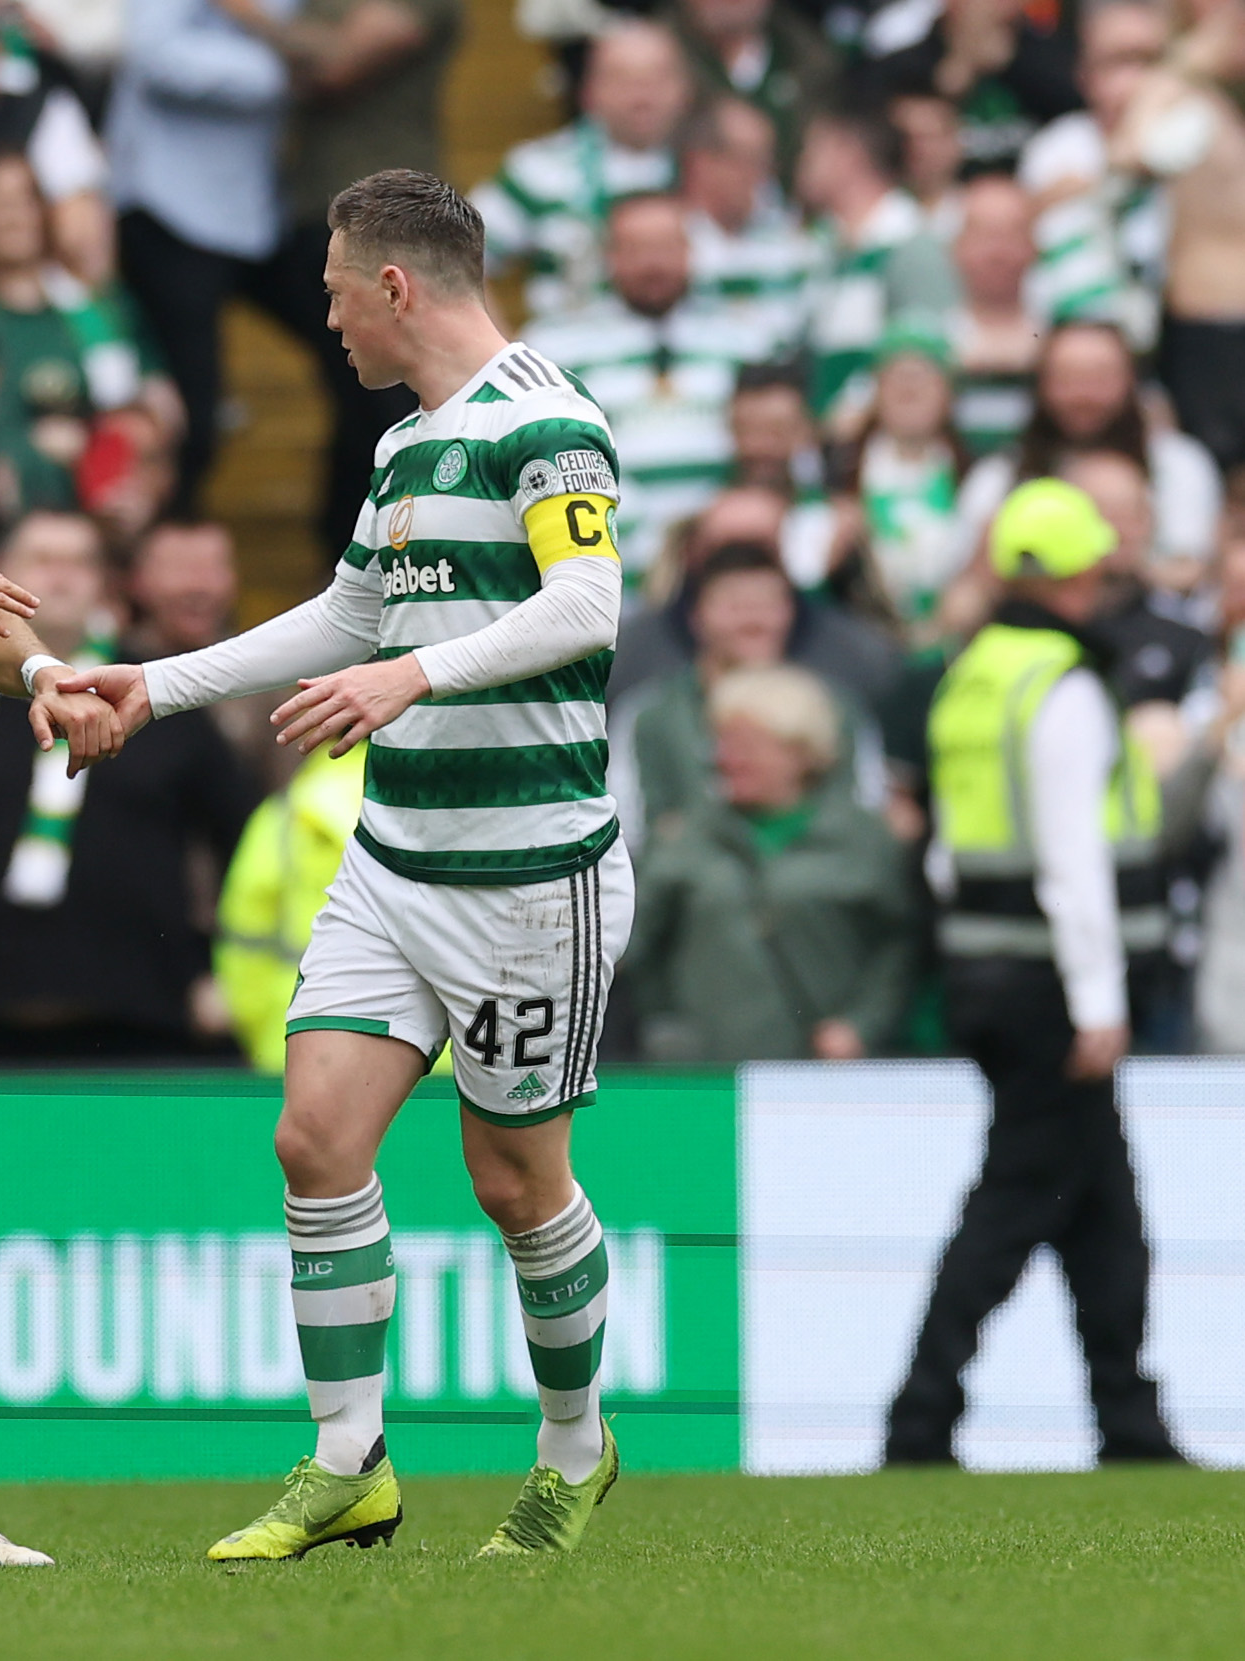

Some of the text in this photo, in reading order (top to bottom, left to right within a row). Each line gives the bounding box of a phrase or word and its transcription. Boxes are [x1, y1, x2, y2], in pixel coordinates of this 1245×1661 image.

[557, 452, 598, 473] CELTIC
[563, 471, 615, 493] FOUND
[565, 500, 602, 546] C
[381, 555, 455, 598] afabet
[465, 996, 556, 1068] 42
[507, 1086, 547, 1100] adidas
[292, 1260, 334, 1275] TIC
